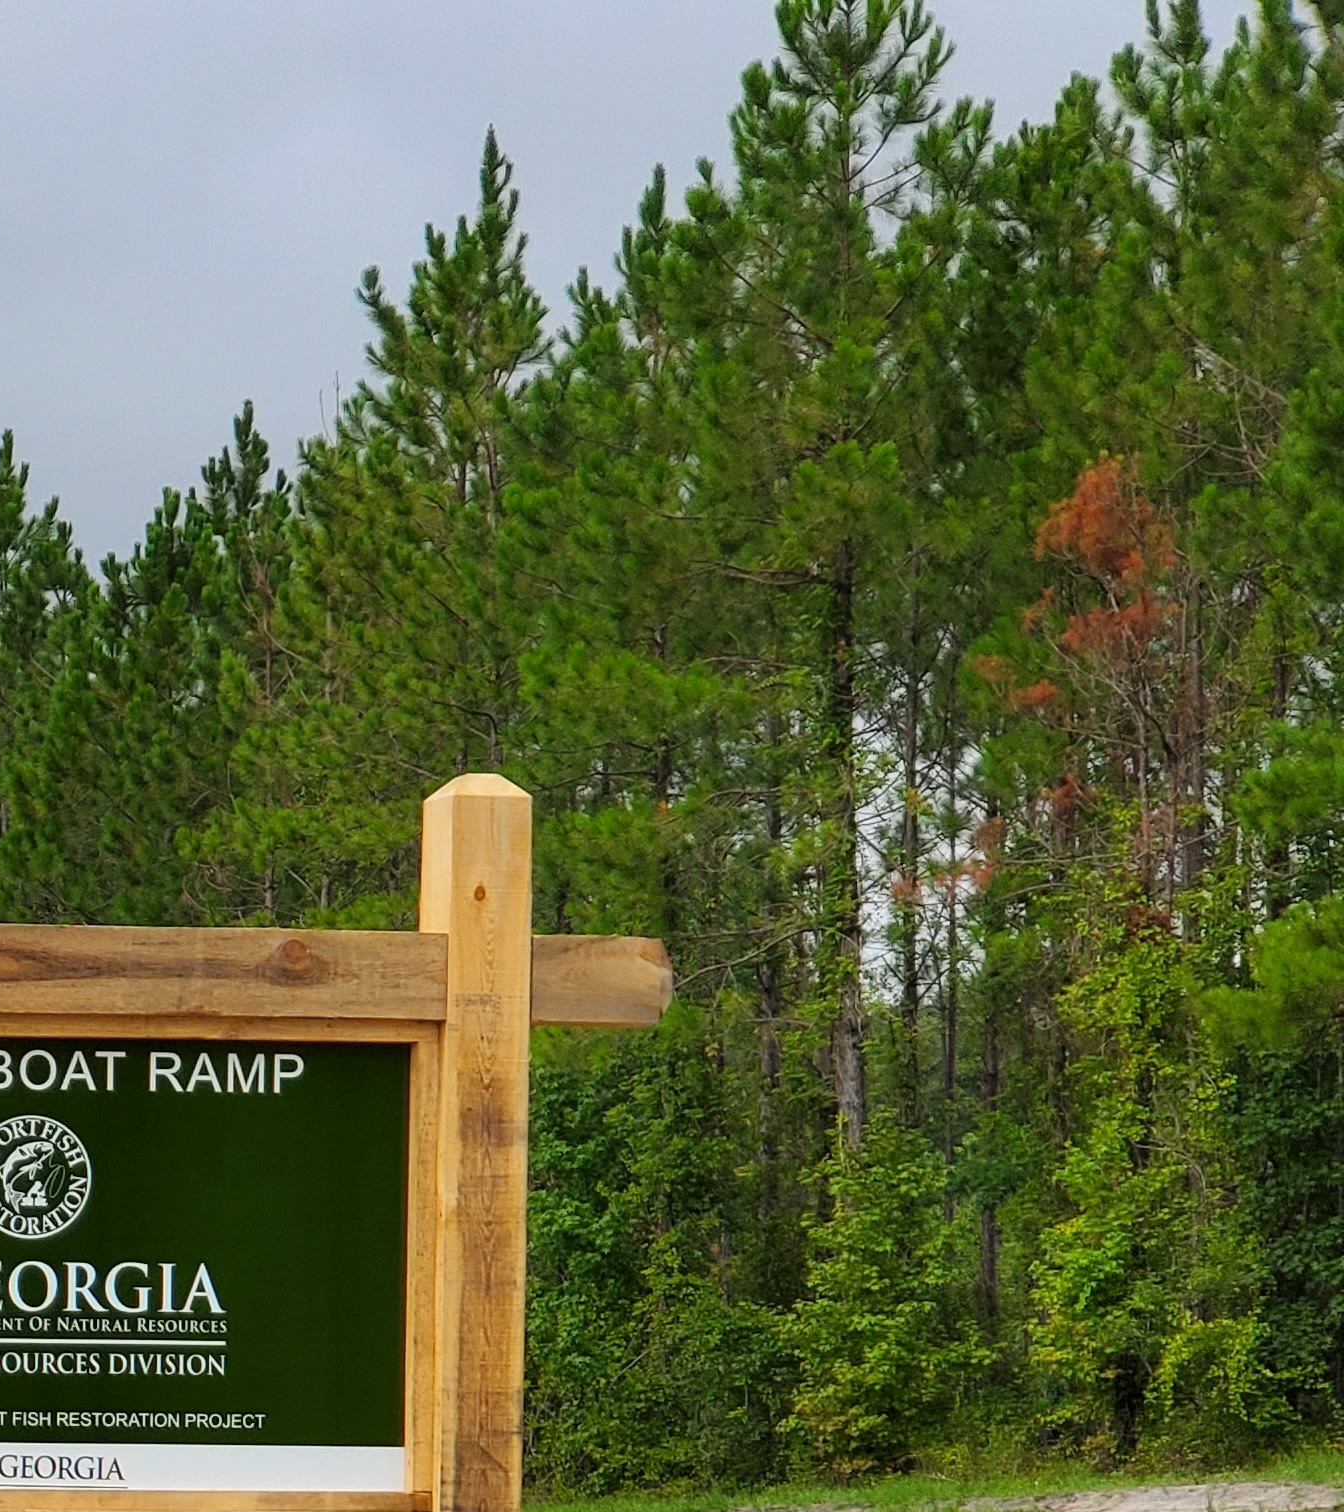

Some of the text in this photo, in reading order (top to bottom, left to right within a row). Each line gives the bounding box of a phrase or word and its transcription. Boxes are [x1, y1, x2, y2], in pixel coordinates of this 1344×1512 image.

[147, 1051, 306, 1095] RAMP
[108, 1353, 227, 1376] DIVISION
[12, 1411, 52, 1427] FISH
[56, 1411, 180, 1428] RESTORATION
[184, 1413, 266, 1429] PROJECT
